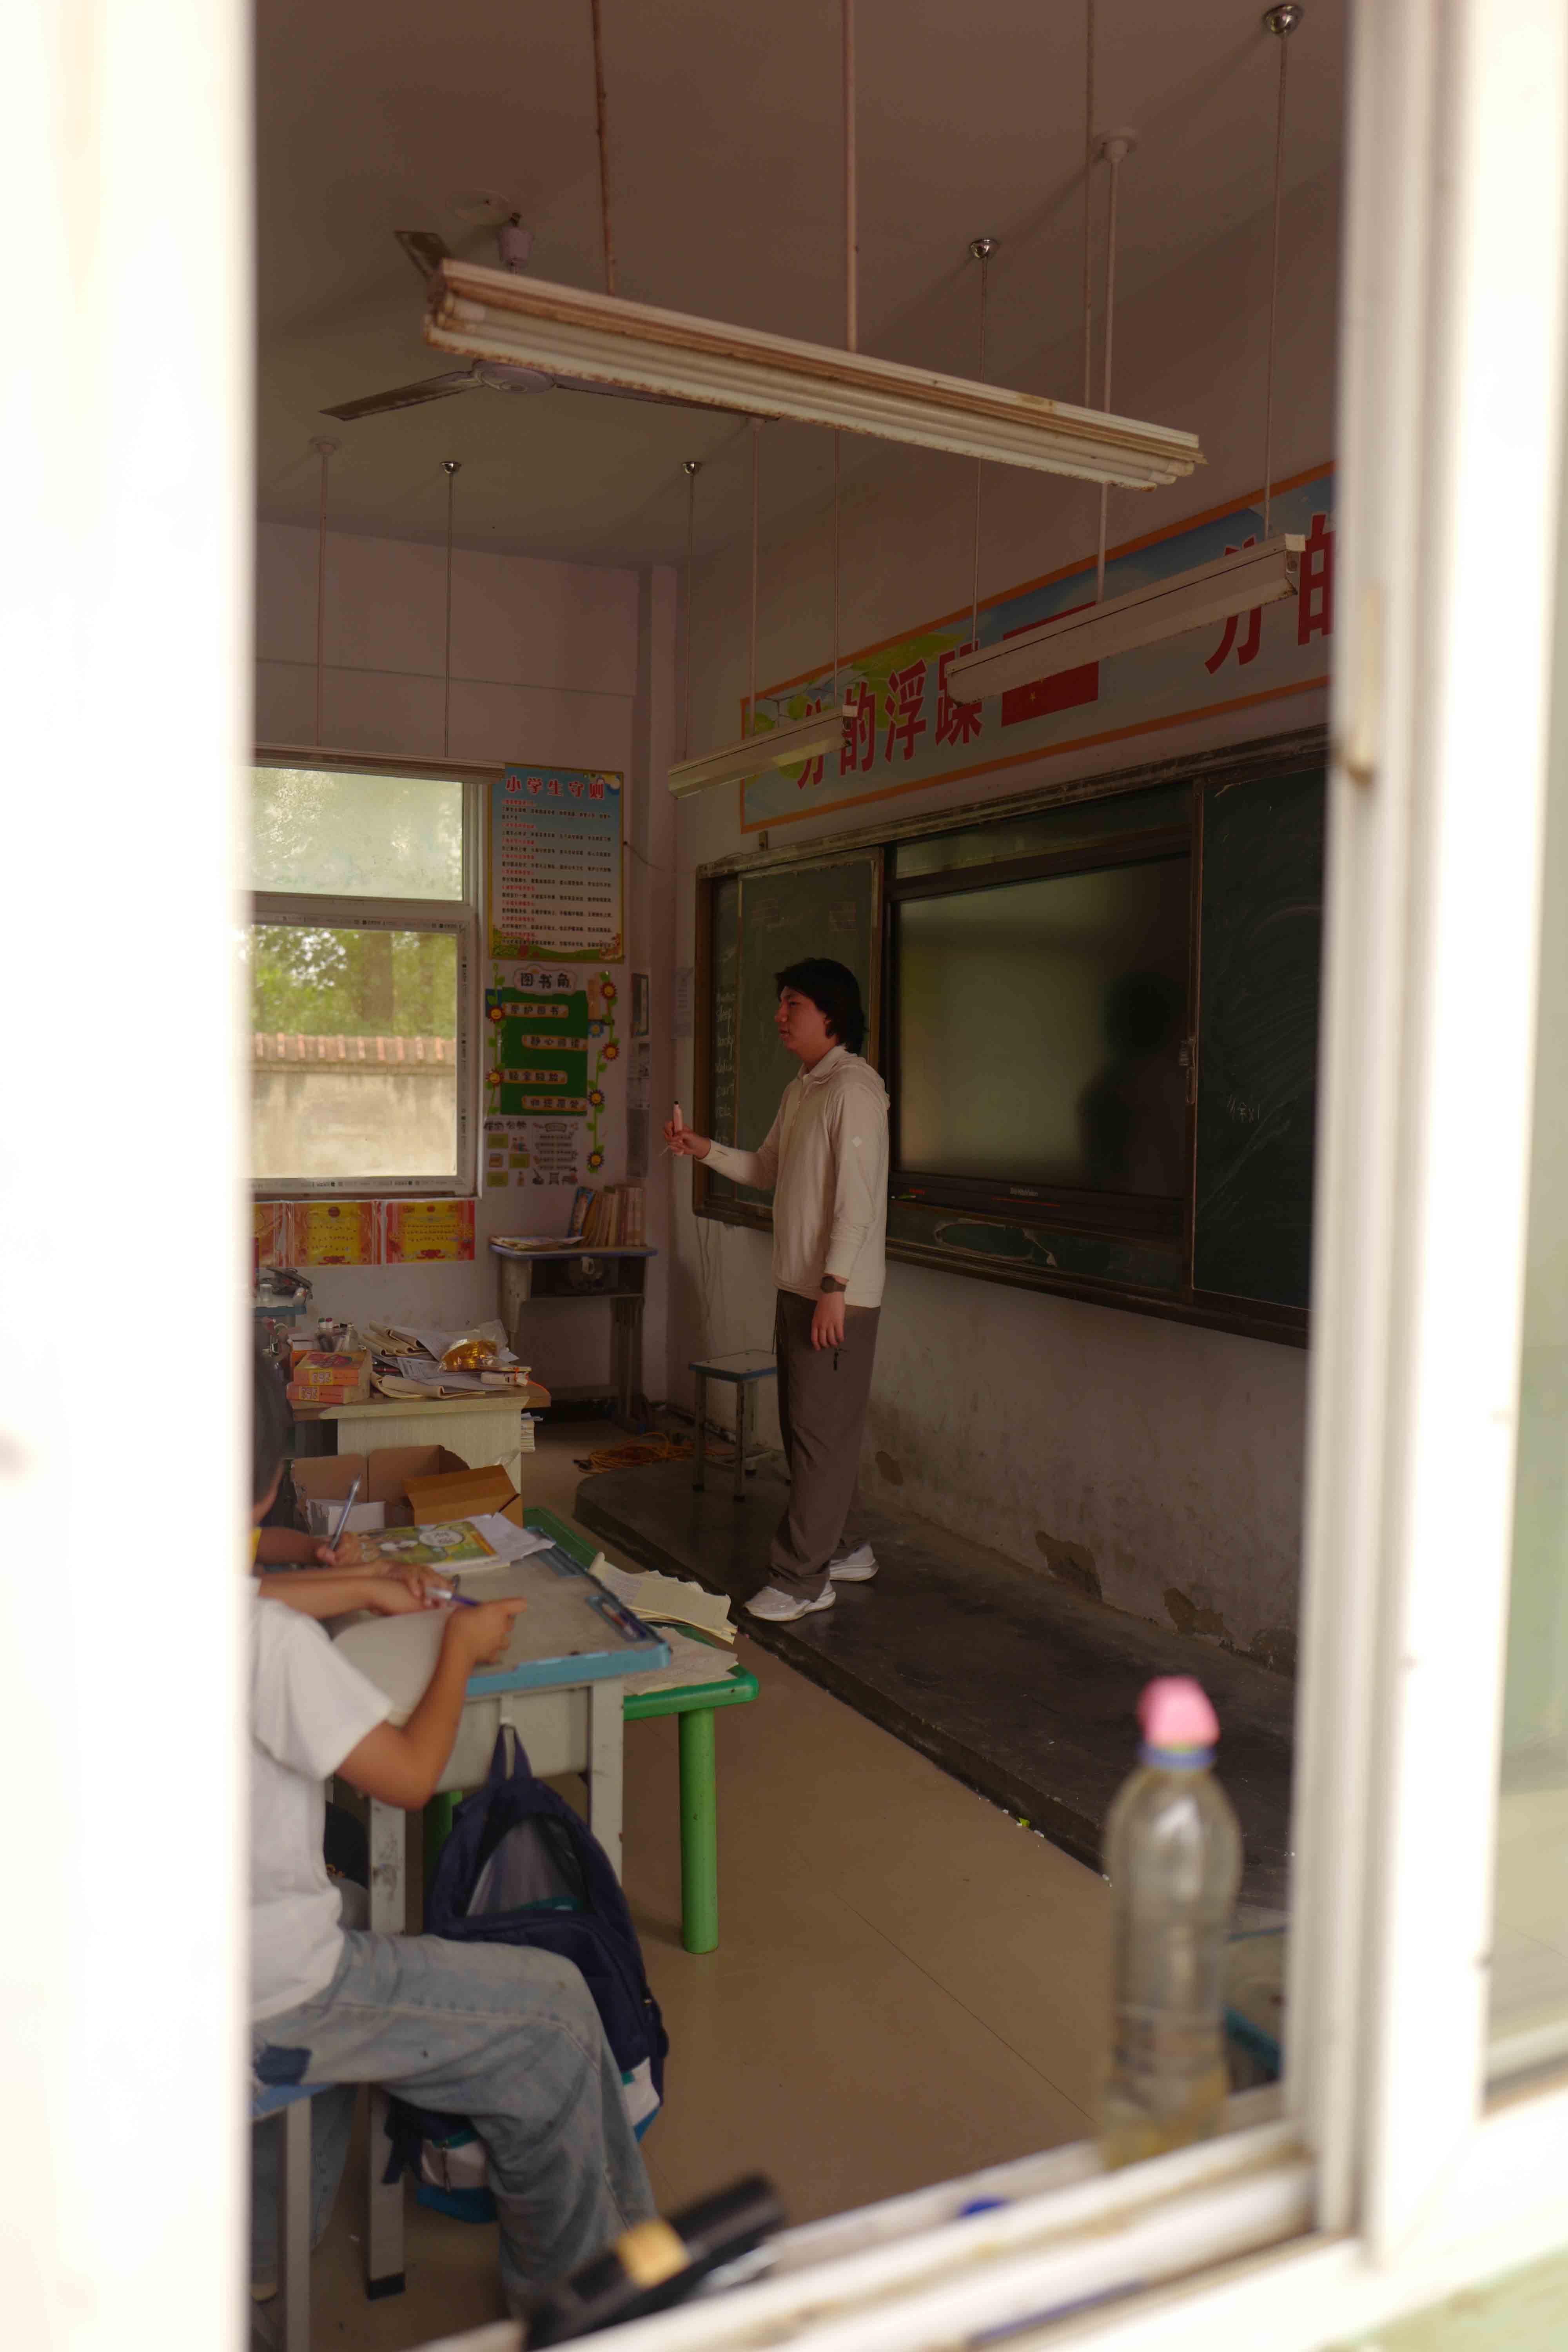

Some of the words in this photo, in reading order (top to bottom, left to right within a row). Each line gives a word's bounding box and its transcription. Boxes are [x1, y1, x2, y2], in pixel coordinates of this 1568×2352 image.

[505, 775, 605, 799] 小学生守则
[520, 972, 571, 989] 图书角
